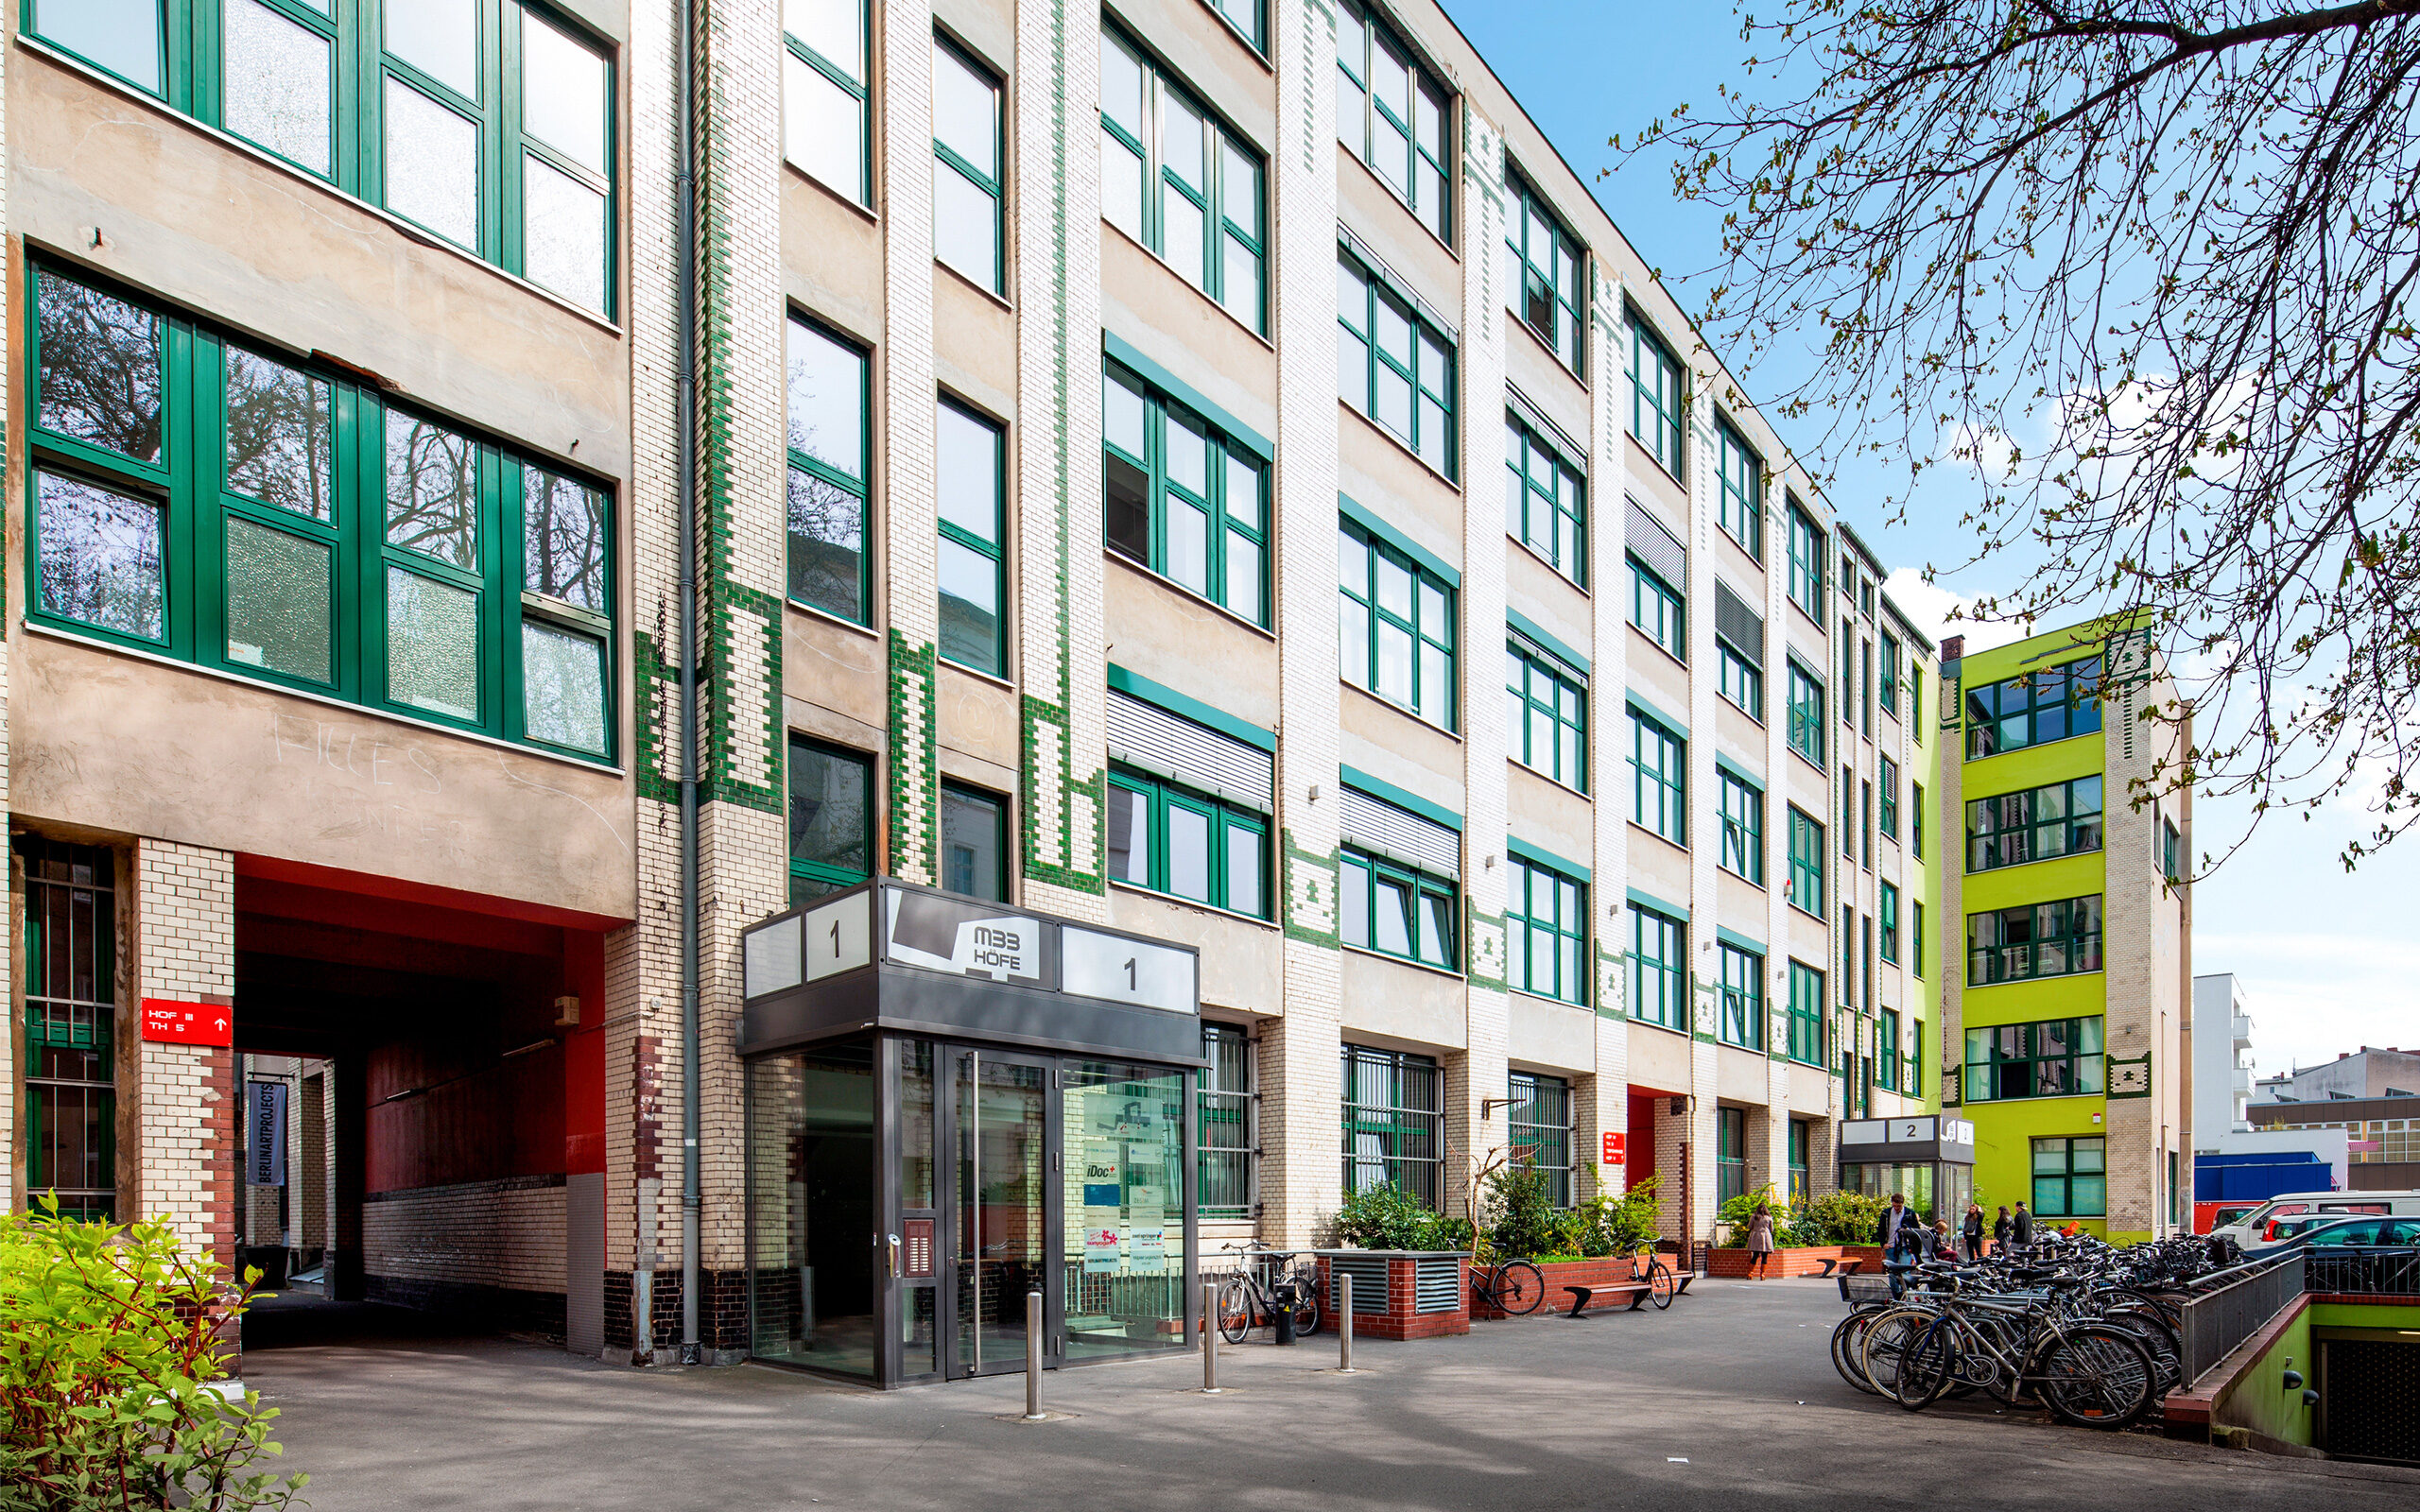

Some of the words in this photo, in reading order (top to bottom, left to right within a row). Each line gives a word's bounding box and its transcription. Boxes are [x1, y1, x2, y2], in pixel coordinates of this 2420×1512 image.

[829, 919, 839, 958] 1
[974, 948, 1021, 971] HÖFE
[1123, 956, 1137, 991] 1
[148, 1009, 178, 1020] HOF
[184, 1012, 194, 1022] III
[148, 1021, 167, 1031] TH
[176, 1023, 185, 1032] 5
[258, 1084, 274, 1184] BERLINARTPROJECTS
[1906, 1124, 1916, 1138] 2
